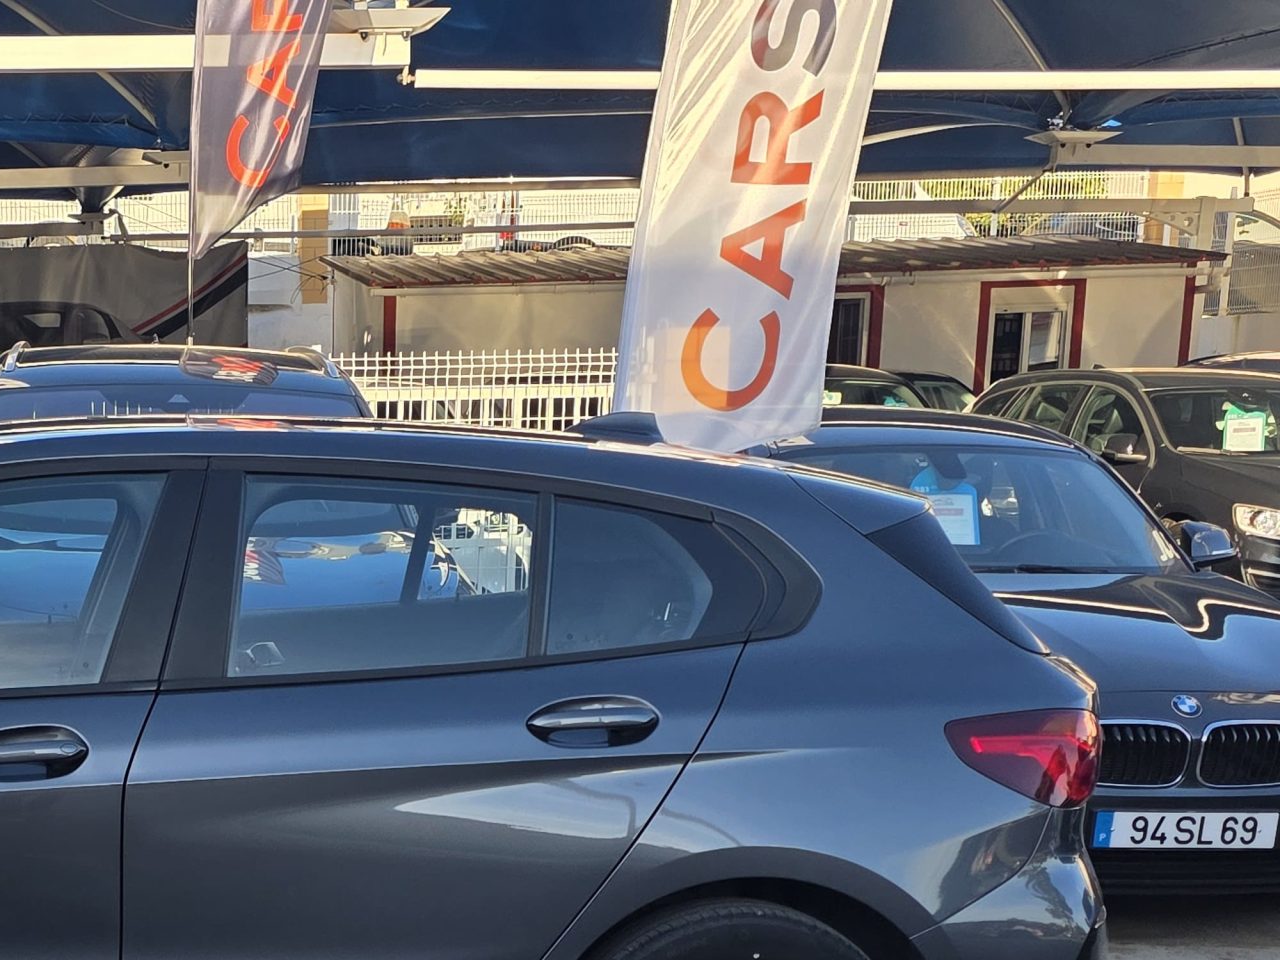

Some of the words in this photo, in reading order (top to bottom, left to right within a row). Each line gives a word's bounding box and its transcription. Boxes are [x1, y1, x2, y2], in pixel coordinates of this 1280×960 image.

[681, 0, 837, 411] CARS
[1130, 816, 1167, 844] 94
[1174, 816, 1213, 845] SL
[1221, 817, 1258, 845] 69
